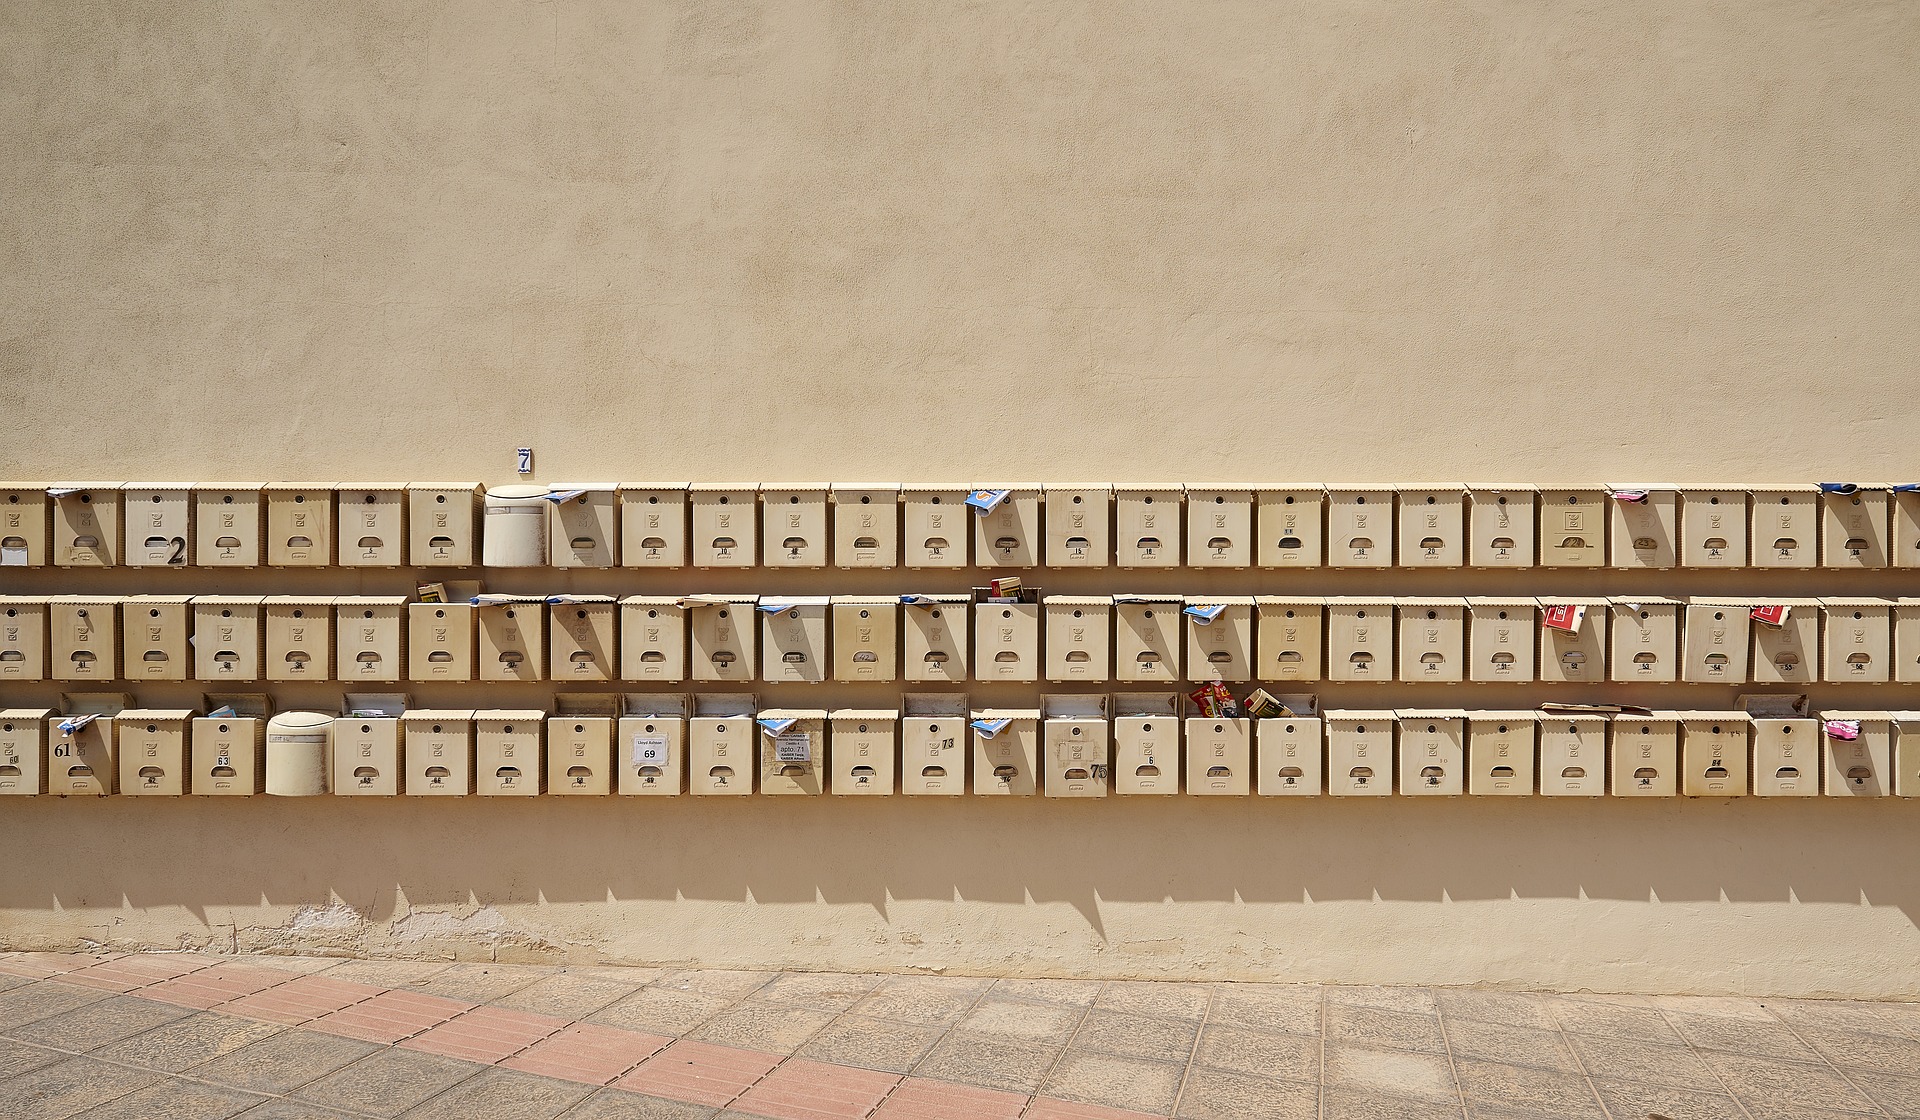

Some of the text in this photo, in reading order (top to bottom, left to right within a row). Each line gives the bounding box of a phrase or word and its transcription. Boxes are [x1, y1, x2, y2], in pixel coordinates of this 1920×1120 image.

[518, 452, 530, 468] 7
[167, 537, 186, 564] 2
[54, 743, 70, 758] 61
[942, 738, 954, 749] 73
[218, 757, 228, 765] 63
[644, 750, 656, 758] 69
[1090, 764, 1107, 778] 75
